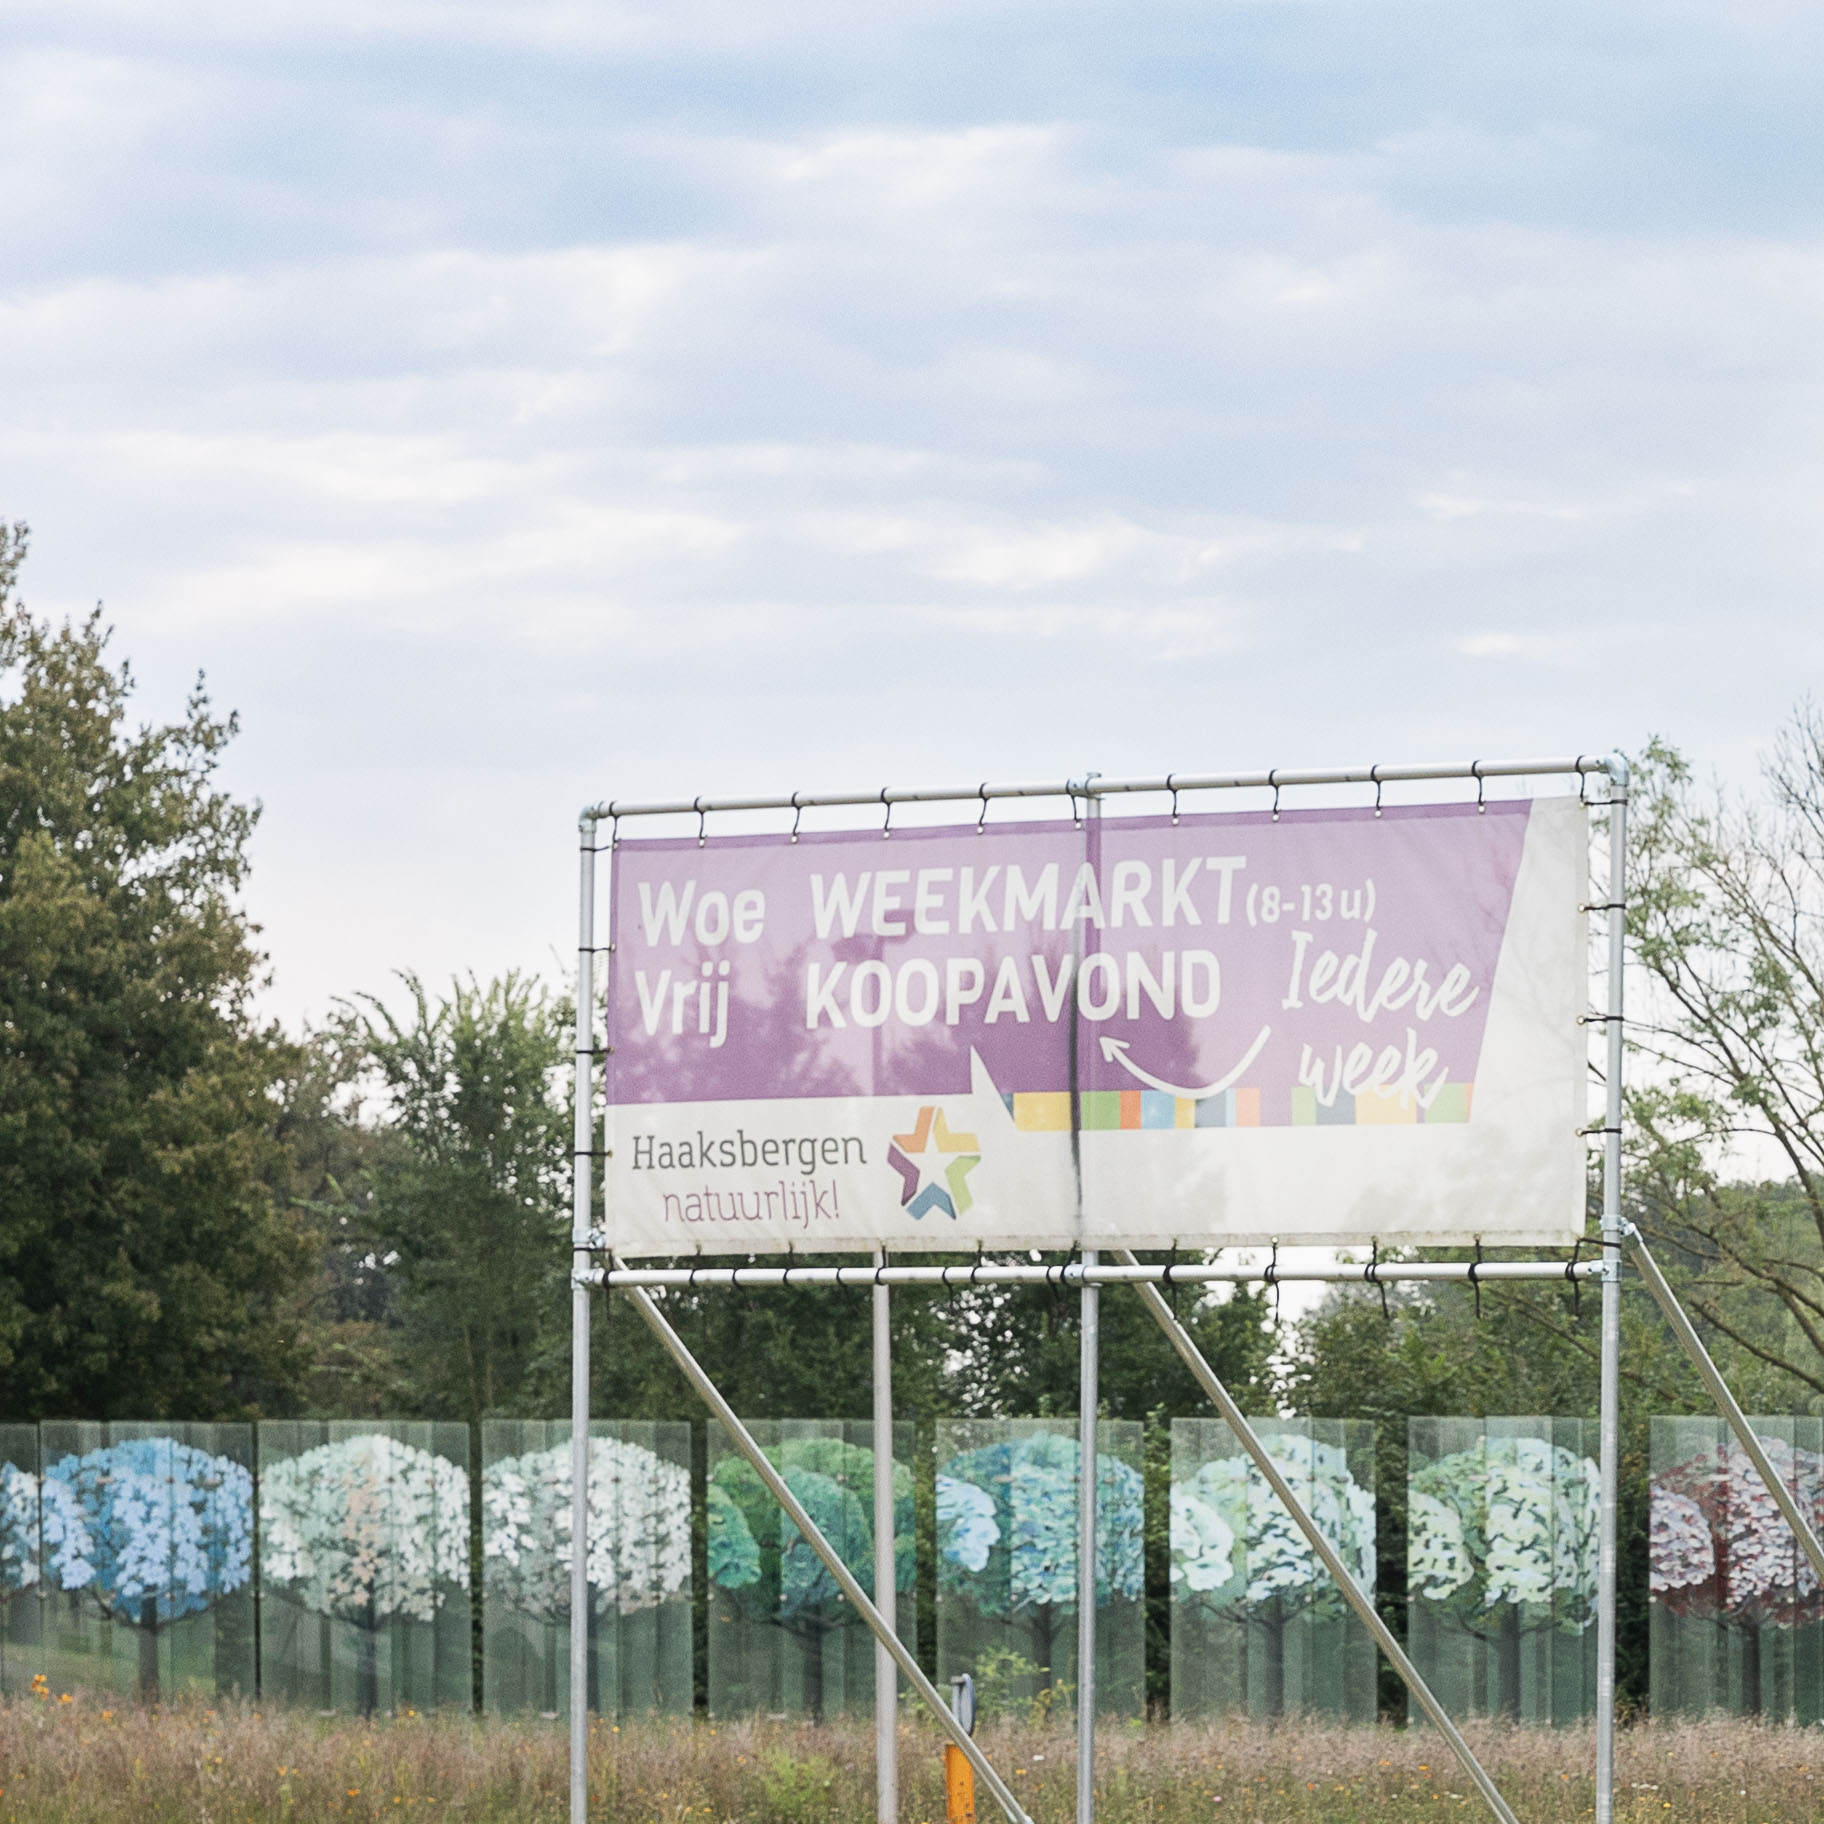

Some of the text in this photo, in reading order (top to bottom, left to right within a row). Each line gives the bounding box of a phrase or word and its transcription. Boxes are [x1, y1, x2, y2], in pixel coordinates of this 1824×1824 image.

[637, 879, 766, 947] Woe
[809, 855, 1248, 940] WEEKMARKT
[634, 948, 1222, 1049] Vrij KOOPAVOND
[1281, 927, 1480, 1023] Iedere
[1297, 1025, 1450, 1110] week
[631, 1129, 868, 1176] Haaksbergen
[662, 1179, 840, 1230] natuurlijk!
